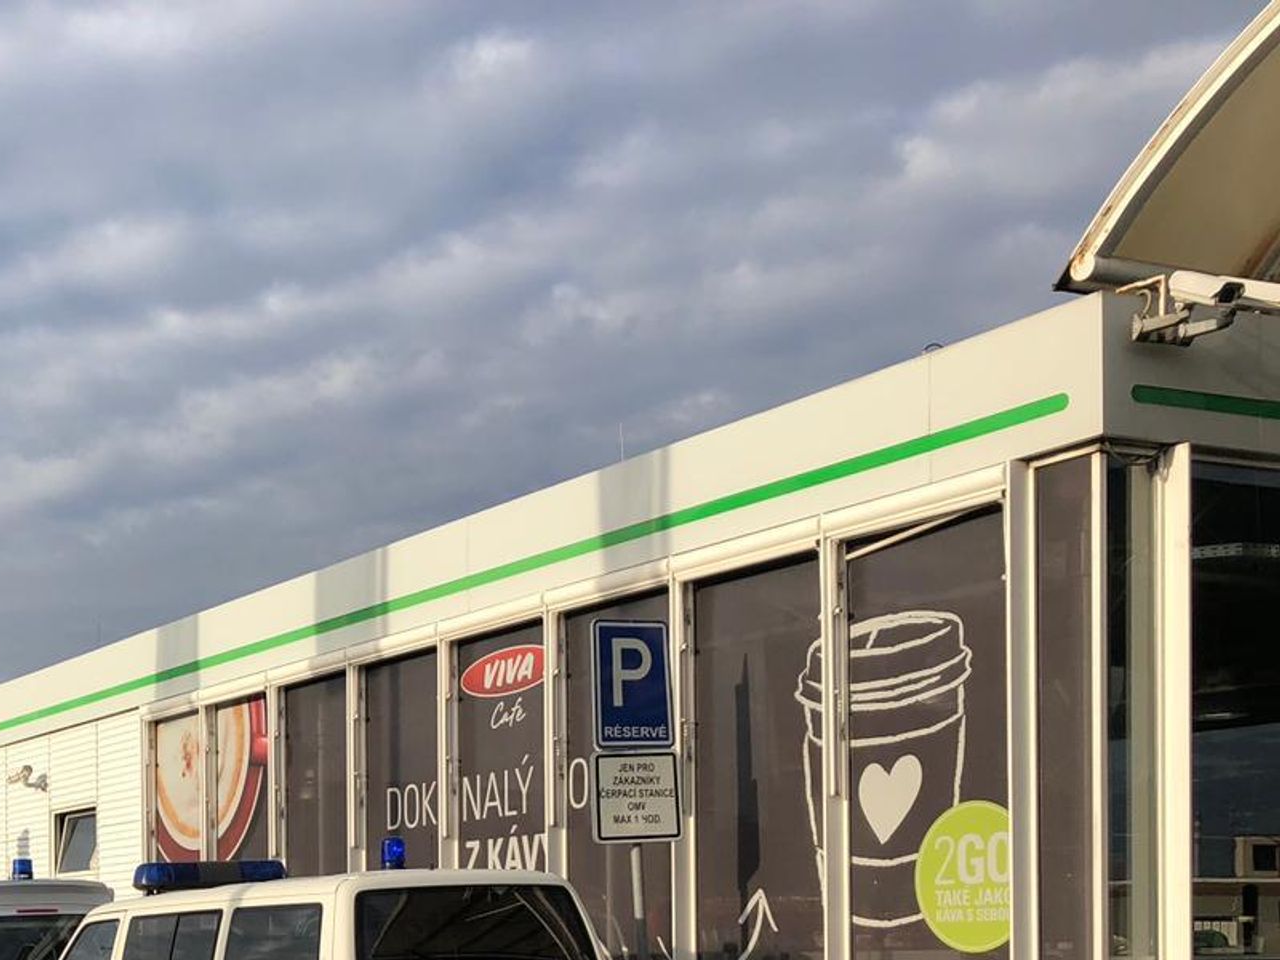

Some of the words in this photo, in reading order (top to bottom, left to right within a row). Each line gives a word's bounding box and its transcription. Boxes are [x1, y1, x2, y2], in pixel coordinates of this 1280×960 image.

[483, 652, 535, 690] VIVA
[610, 637, 653, 708] P
[618, 763, 635, 773] JEN
[636, 763, 655, 773] PRO
